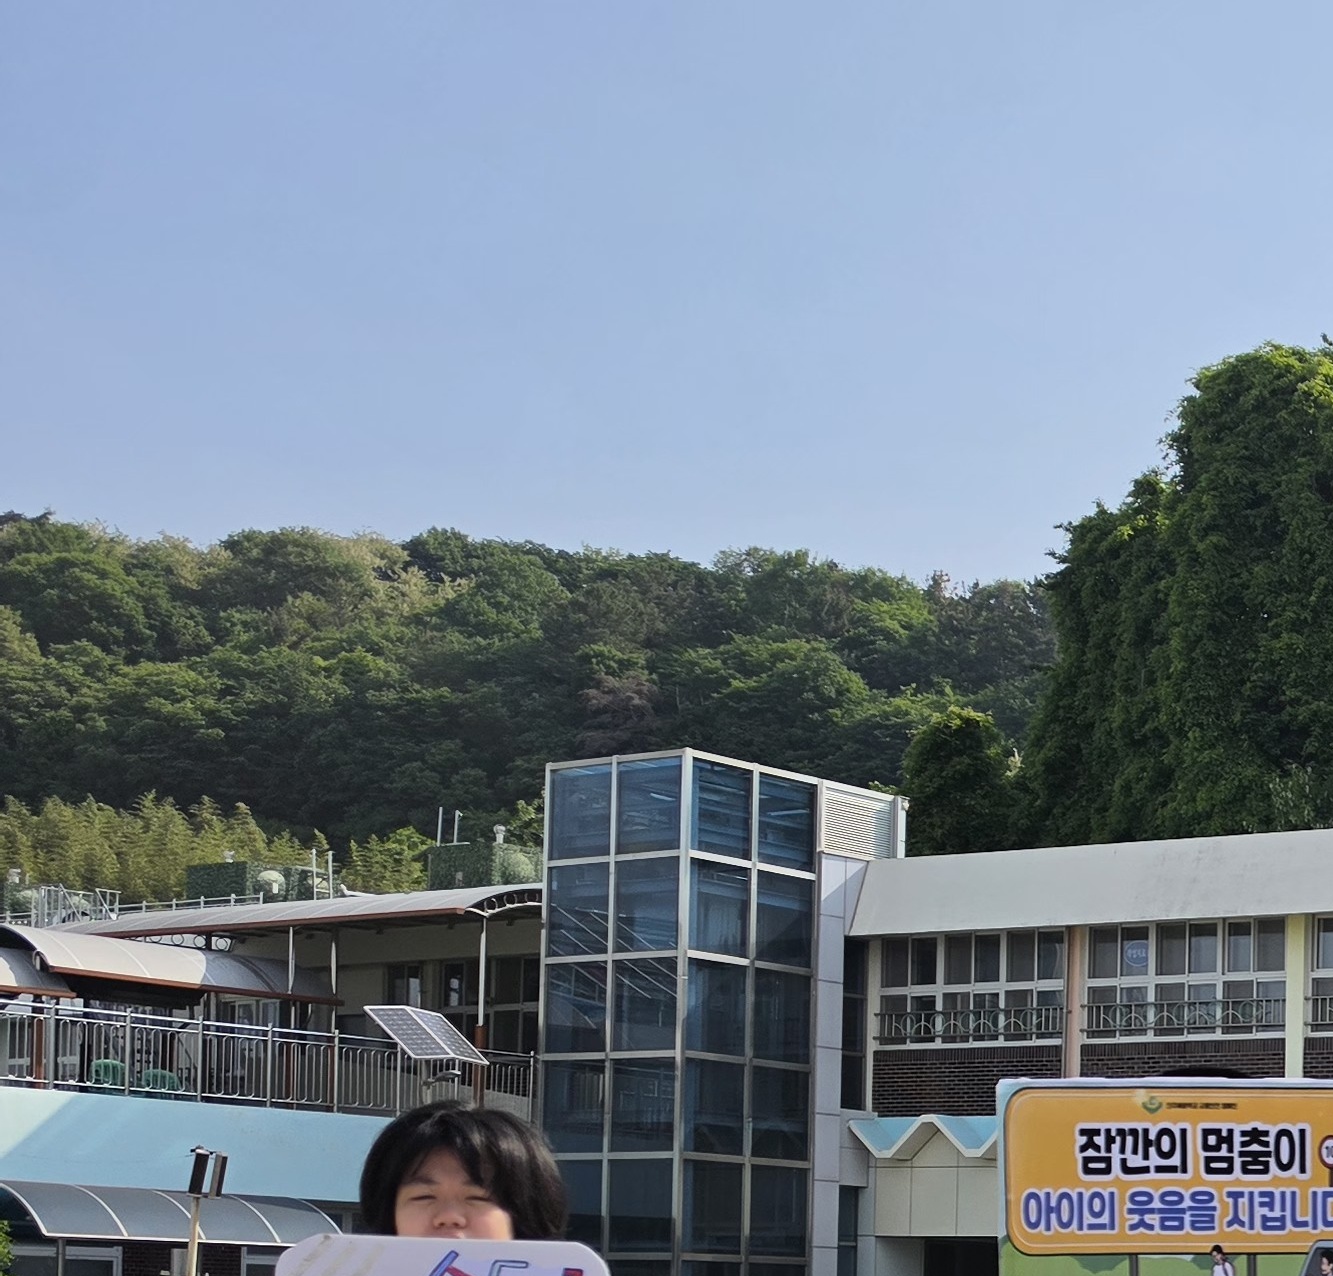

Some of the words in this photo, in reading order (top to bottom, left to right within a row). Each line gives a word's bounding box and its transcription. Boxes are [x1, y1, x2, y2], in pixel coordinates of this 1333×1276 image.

[1078, 1127, 1187, 1175] 잠깐의
[1202, 1127, 1307, 1175] 멈춤이
[1022, 1190, 1116, 1232] 아이의
[1126, 1190, 1217, 1232] 웃음을
